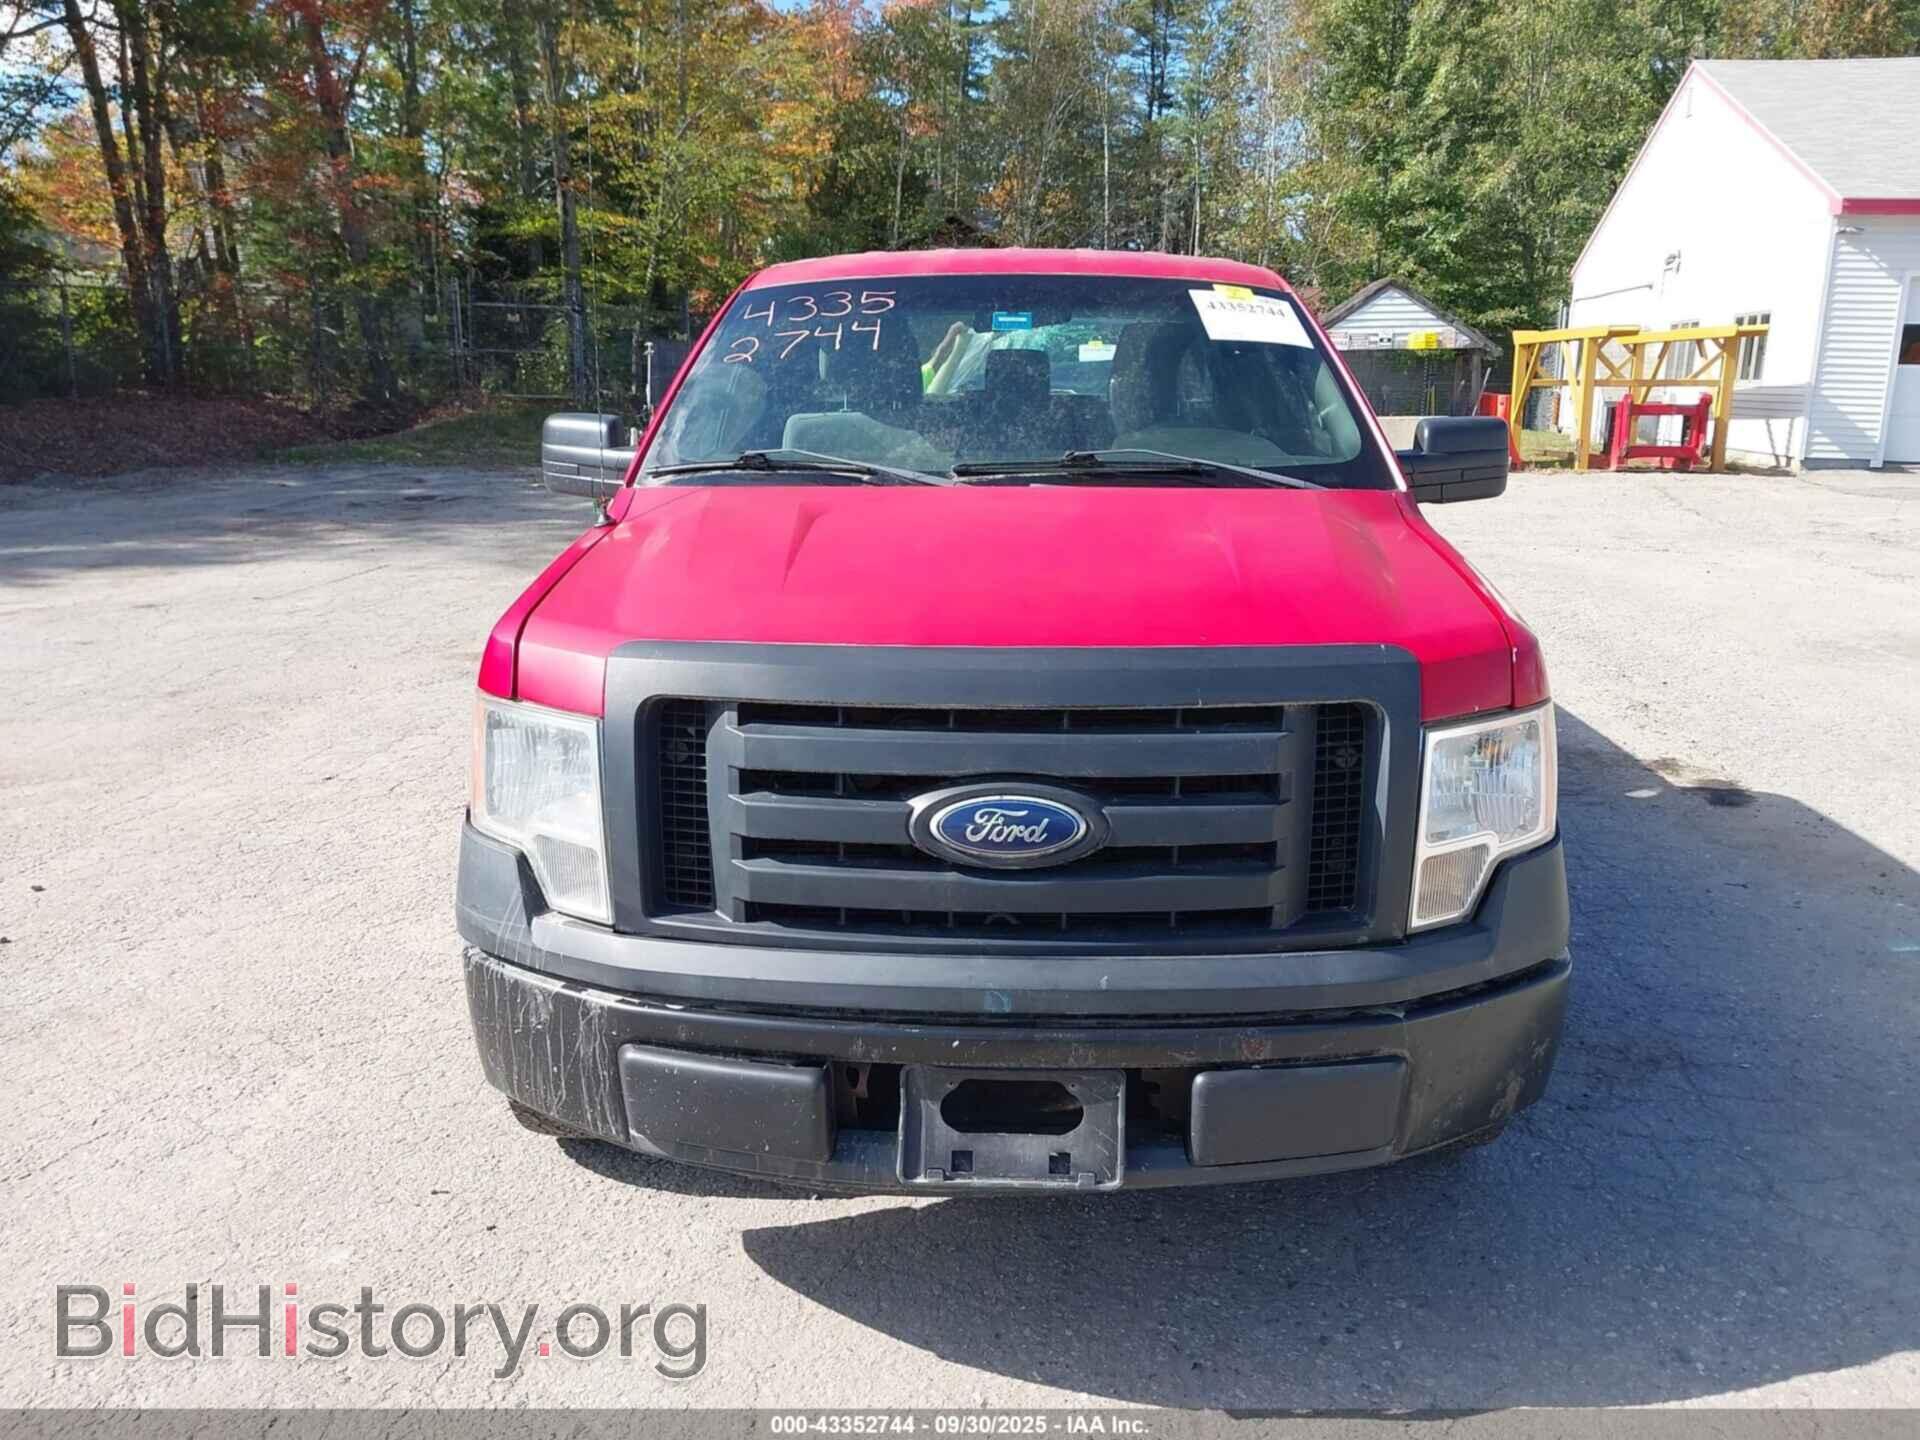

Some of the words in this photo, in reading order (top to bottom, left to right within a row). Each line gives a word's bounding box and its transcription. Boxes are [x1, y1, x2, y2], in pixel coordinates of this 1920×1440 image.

[743, 291, 897, 327] 4335
[723, 318, 881, 364] 2744
[965, 807, 1049, 844] Ford
